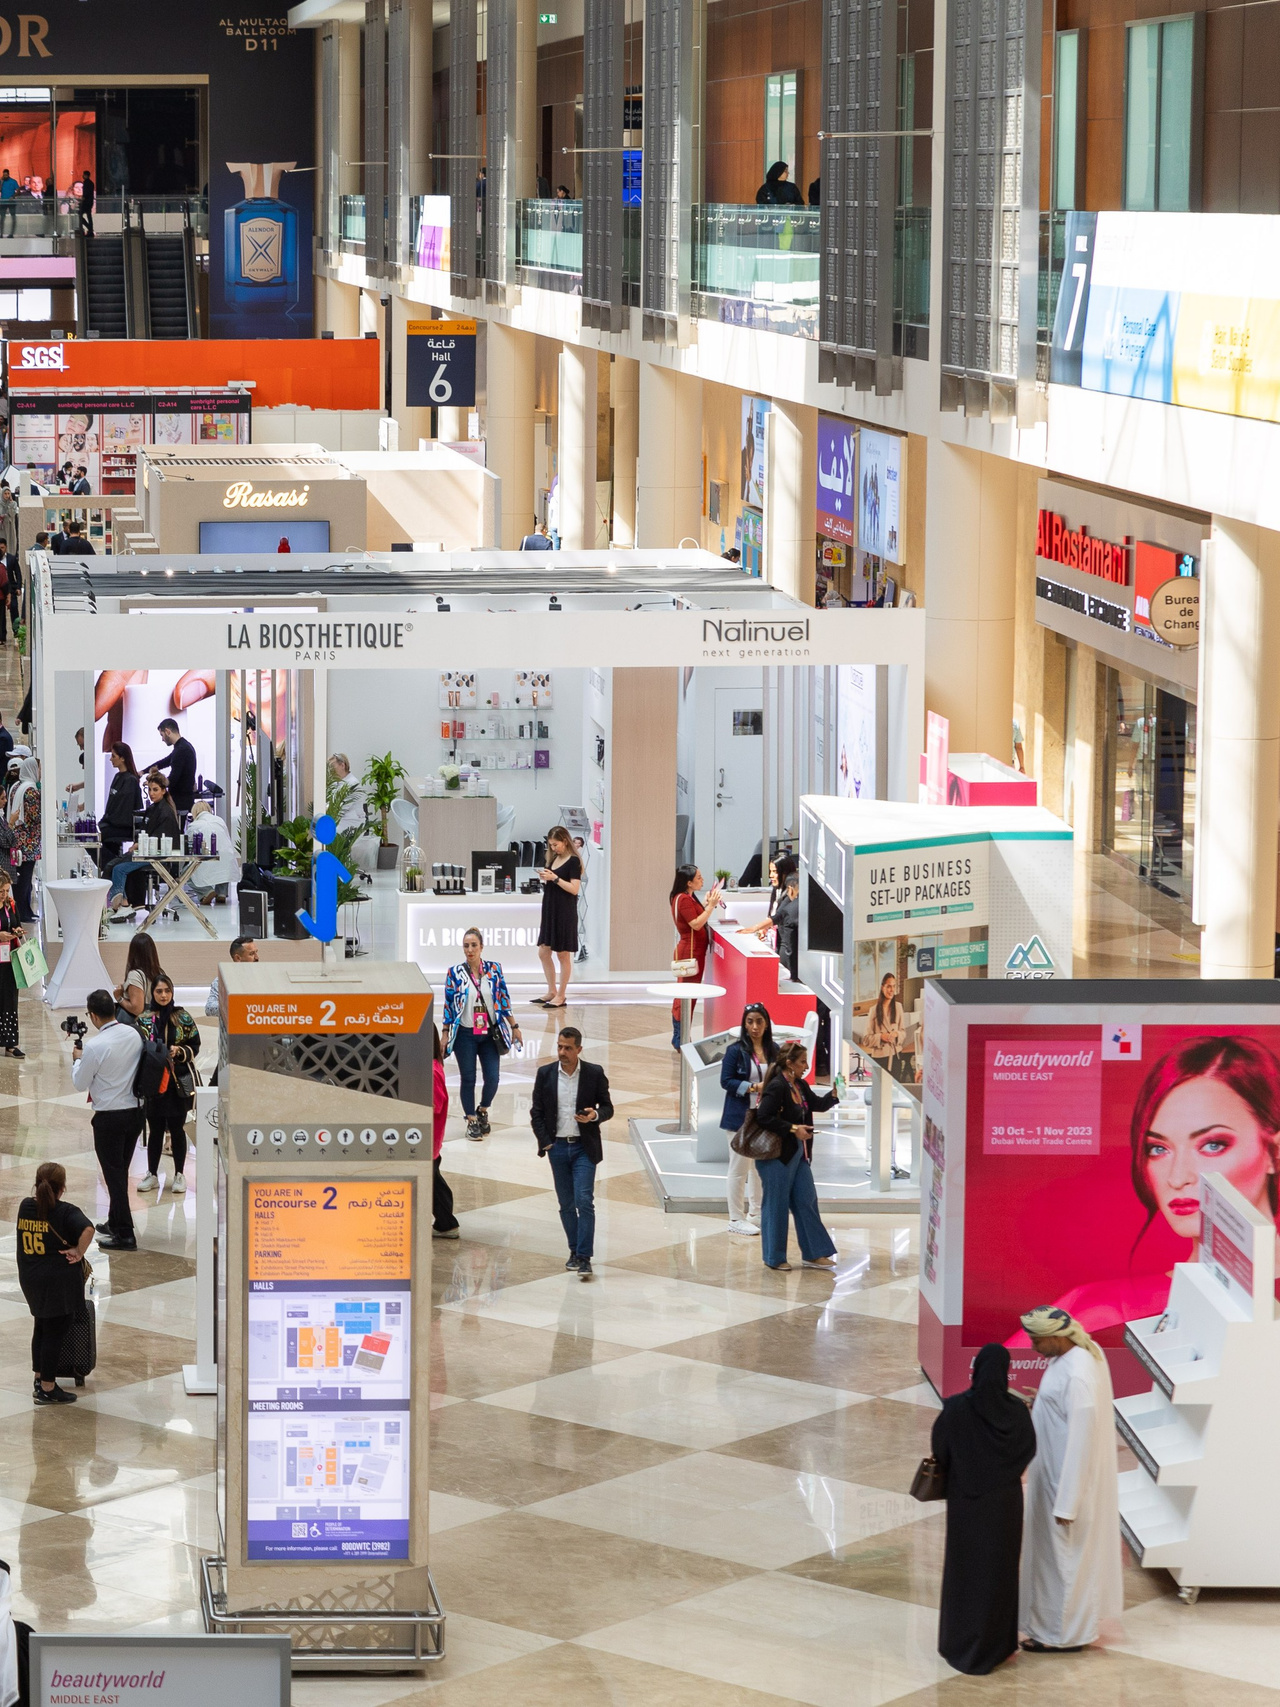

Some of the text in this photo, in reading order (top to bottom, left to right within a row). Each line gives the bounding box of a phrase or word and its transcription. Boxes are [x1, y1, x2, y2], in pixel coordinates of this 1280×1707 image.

[219, 18, 236, 26] AL
[225, 27, 298, 36] BALLROOM
[245, 38, 278, 52] D11
[427, 338, 456, 349] قاعة
[21, 346, 62, 368] SGS
[432, 352, 451, 361] Hall
[428, 363, 452, 403] 6
[223, 482, 310, 508] Rasasi
[1165, 596, 1199, 605] Burea
[1179, 608, 1194, 617] de
[703, 618, 809, 641] Natinuel
[1164, 620, 1200, 630] Chang
[228, 624, 251, 648] LA
[296, 651, 336, 660] PARIS
[739, 649, 810, 658] generation
[871, 859, 971, 884] UAE BUSINESS
[870, 880, 971, 906] SET-UP PACKAGES
[420, 928, 437, 947] LA
[938, 943, 985, 957] COWORKING SPACE
[951, 956, 971, 966] OFFICES
[246, 1004, 297, 1013] YOU ARE IN
[246, 1000, 336, 1026] Concourse 2
[344, 1012, 404, 1026] ردهة رقم
[994, 1050, 1093, 1070] beautyworld
[993, 1072, 1054, 1080] MIDDLE EAST
[992, 1127, 1093, 1136] 30 Oct Nov 2023
[254, 1189, 271, 1197] YOU
[254, 1186, 338, 1210] Concourse 2
[348, 1197, 404, 1209] ردهة رقم
[18, 1218, 48, 1232] MOTHER
[22, 1232, 45, 1254] 06
[253, 1282, 274, 1290] HALLS
[253, 1402, 279, 1410] MEETING
[342, 1542, 371, 1550] 800DWTC
[372, 1542, 390, 1551] (3982)
[51, 1670, 165, 1692] beautyworld
[50, 1695, 120, 1704] MIDDLE EAST
